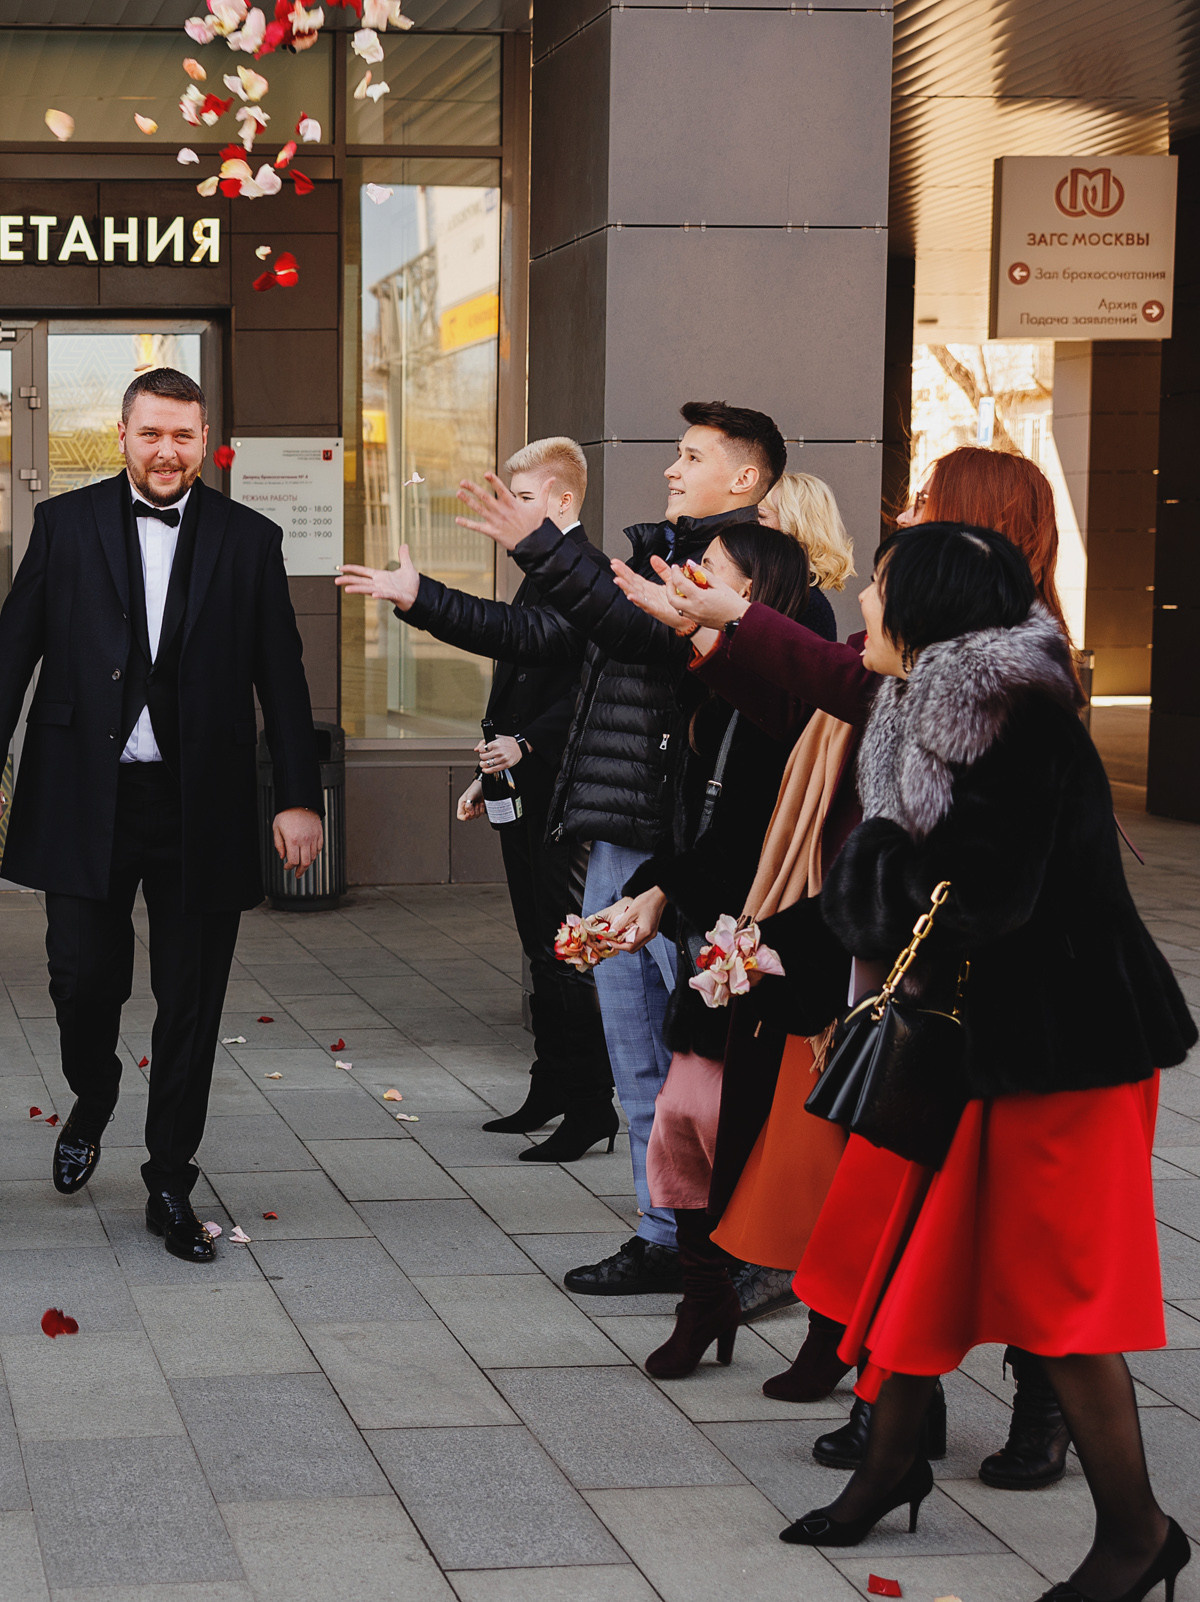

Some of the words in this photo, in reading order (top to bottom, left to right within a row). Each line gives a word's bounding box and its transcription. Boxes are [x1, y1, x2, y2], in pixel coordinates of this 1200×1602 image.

[1027, 232, 1068, 246] ЗАГС
[1072, 232, 1150, 246] МОСКВЫ
[1035, 268, 1058, 280] Зал
[1062, 267, 1166, 283] бракосочетания
[1098, 299, 1138, 313] Архив
[1020, 313, 1068, 326] Подача
[1072, 314, 1137, 325] заявлений
